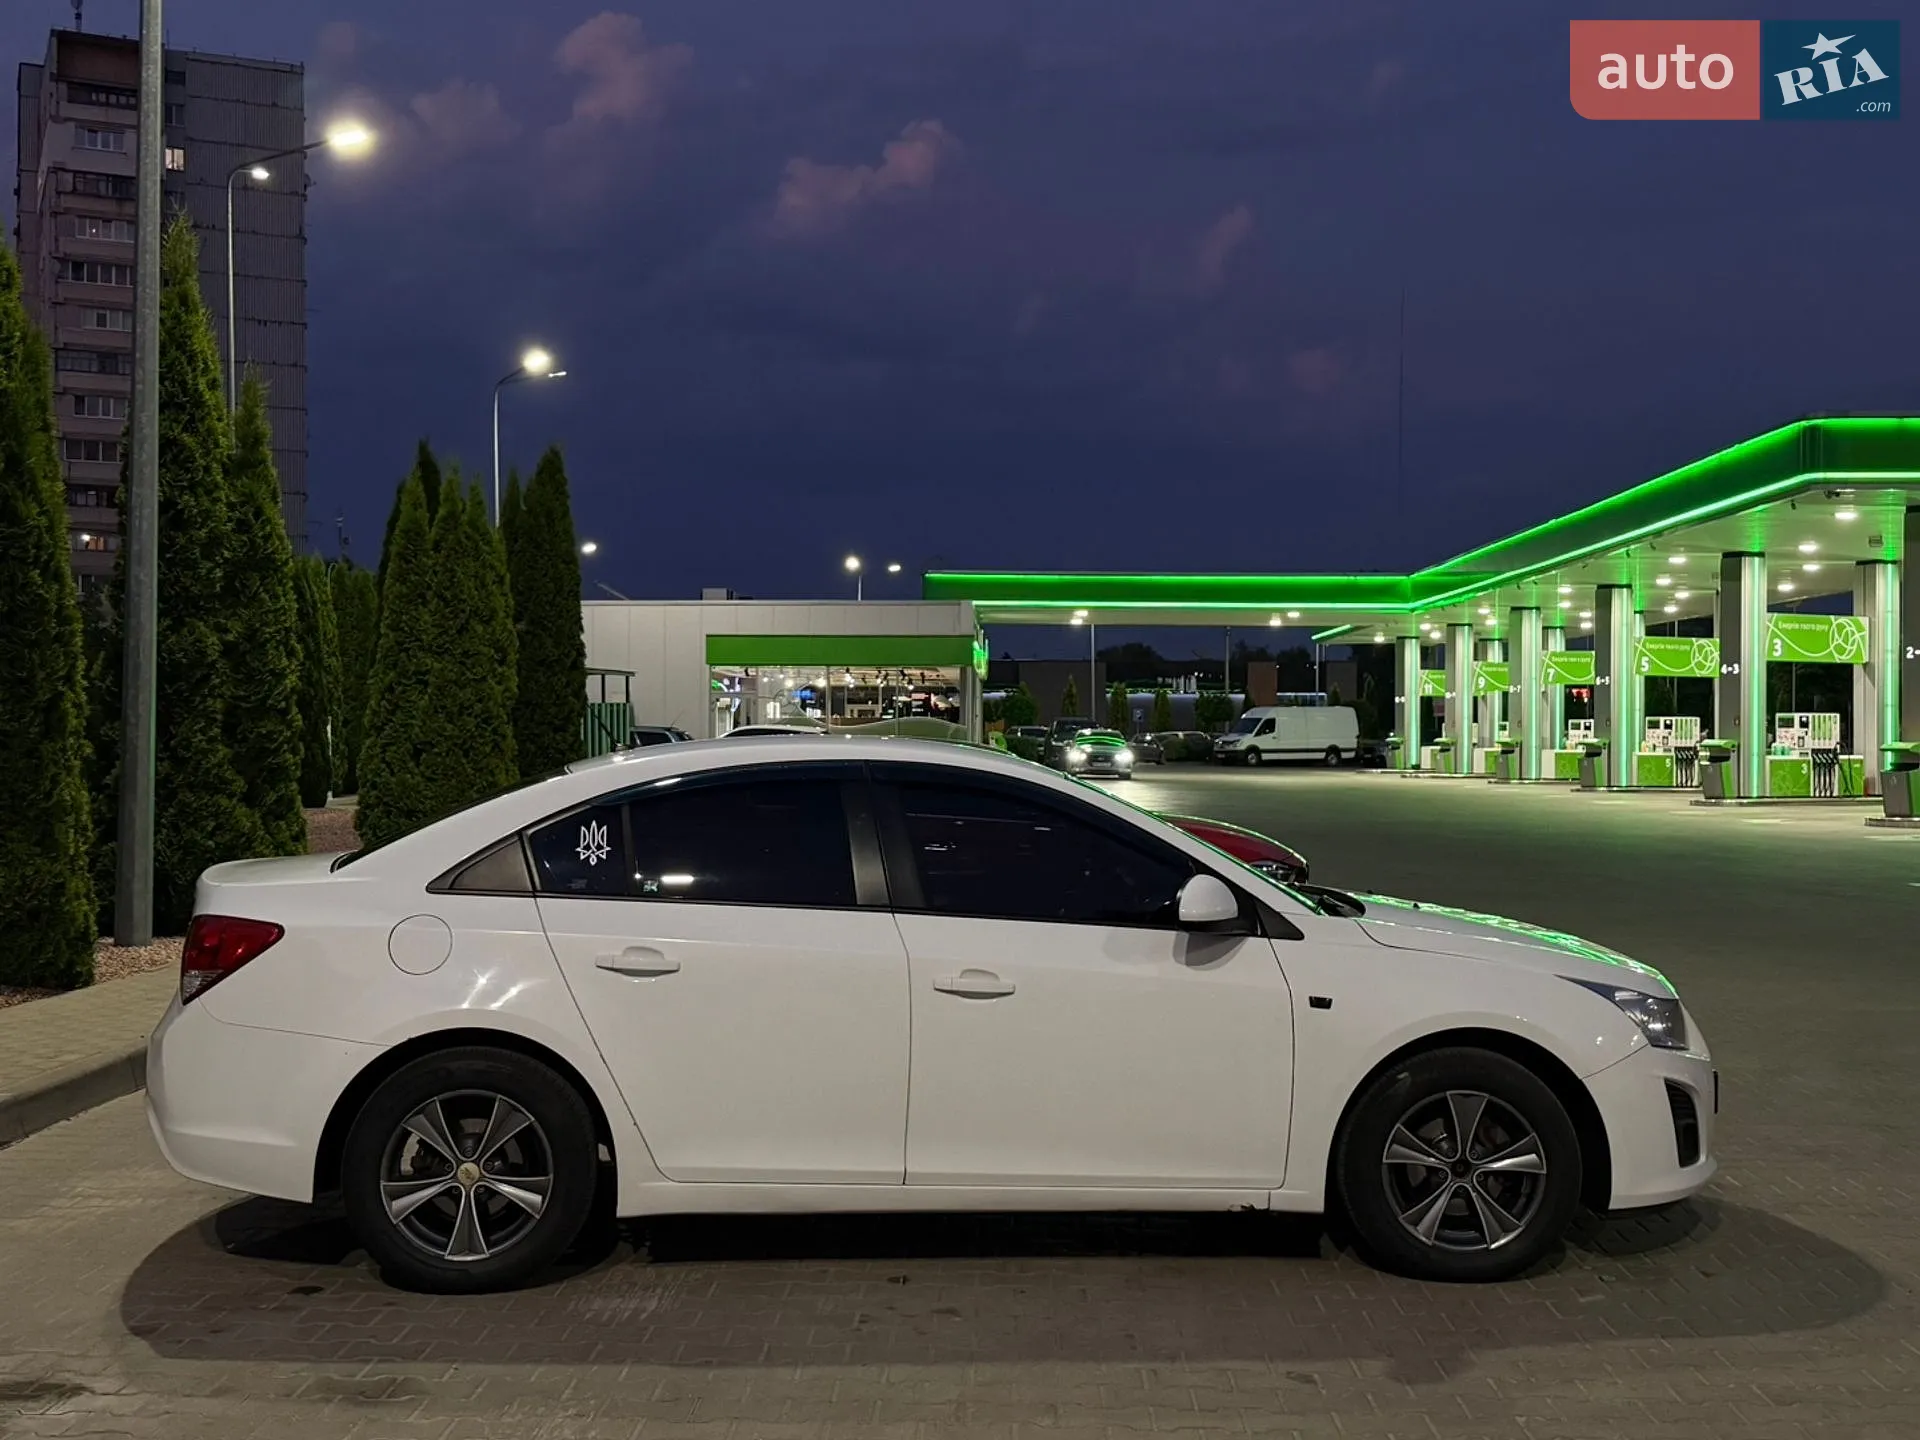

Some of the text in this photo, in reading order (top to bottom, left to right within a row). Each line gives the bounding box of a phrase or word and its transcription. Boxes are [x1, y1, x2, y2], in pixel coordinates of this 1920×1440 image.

[1772, 638, 1782, 657] 3
[1641, 656, 1650, 672] 5
[1547, 668, 1556, 682] 7
[1424, 683, 1433, 695] 11
[1478, 676, 1486, 689] 9
